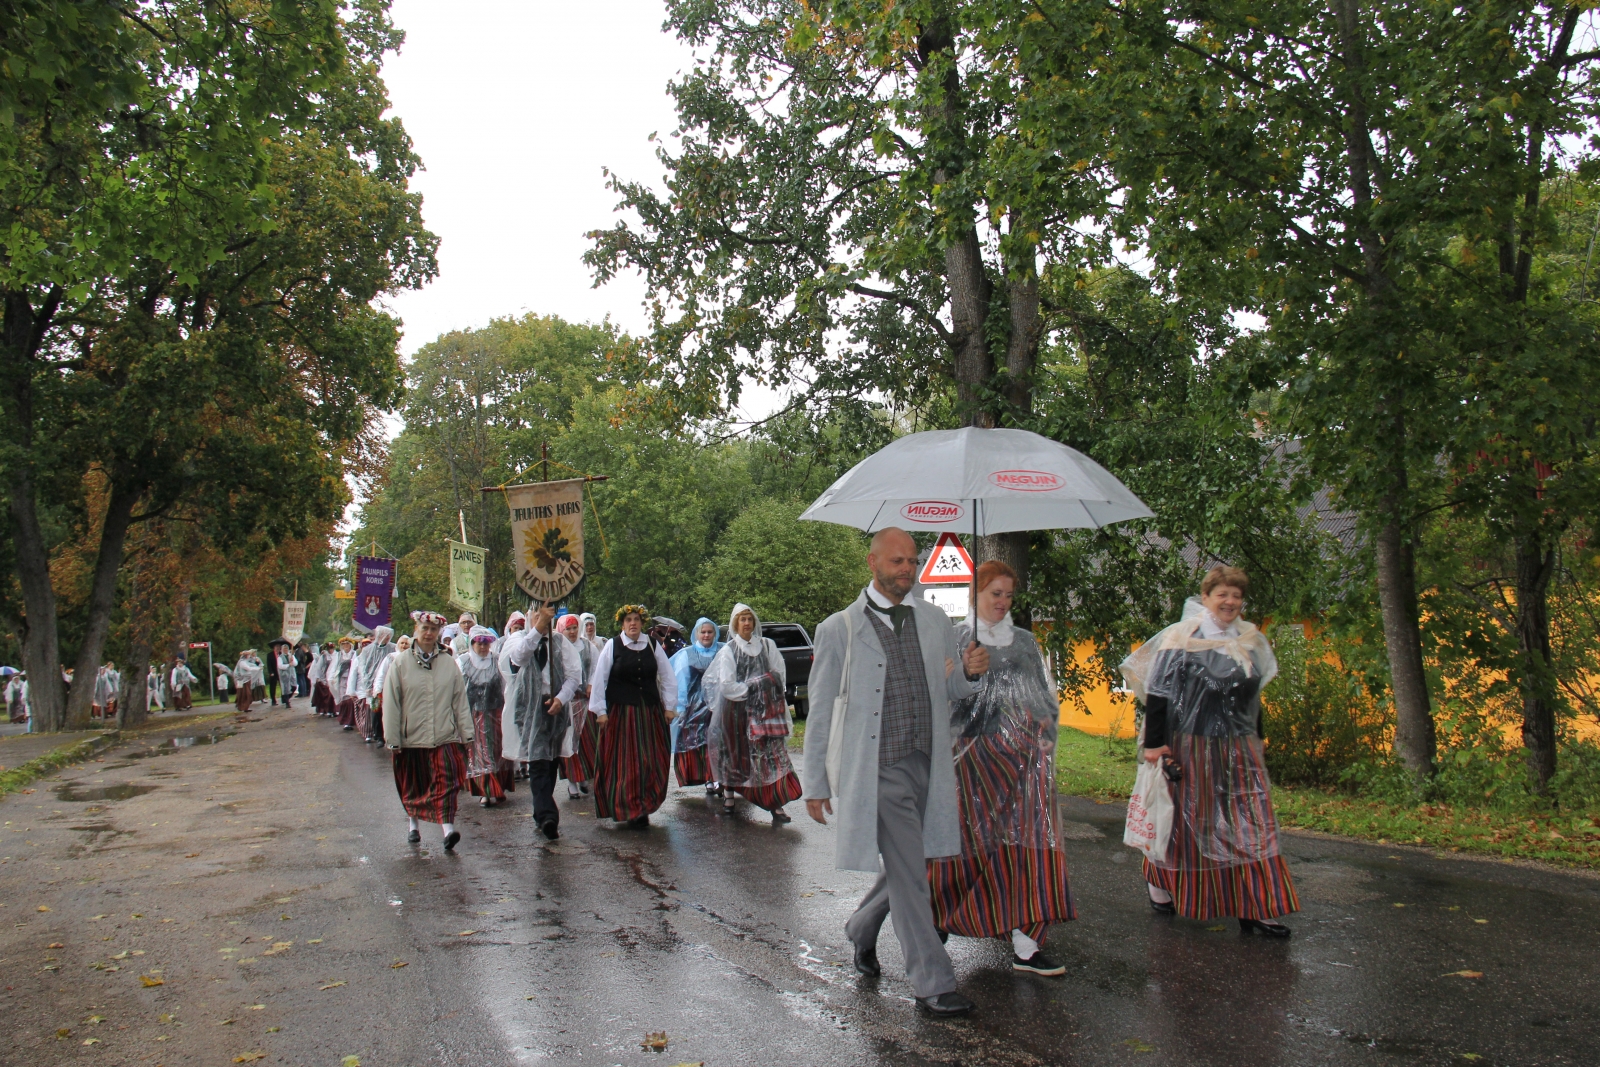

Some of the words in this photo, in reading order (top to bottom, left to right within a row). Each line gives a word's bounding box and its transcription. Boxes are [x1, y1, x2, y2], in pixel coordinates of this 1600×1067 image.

[997, 474, 1057, 485] MEGUIN
[513, 505, 554, 522] JAUKTAIS
[556, 500, 581, 516] KORIS
[453, 549, 482, 564] ZANTES
[362, 567, 389, 577] JAUNPILS
[365, 576, 384, 585] KORIS
[518, 560, 584, 598] KANDAVA
